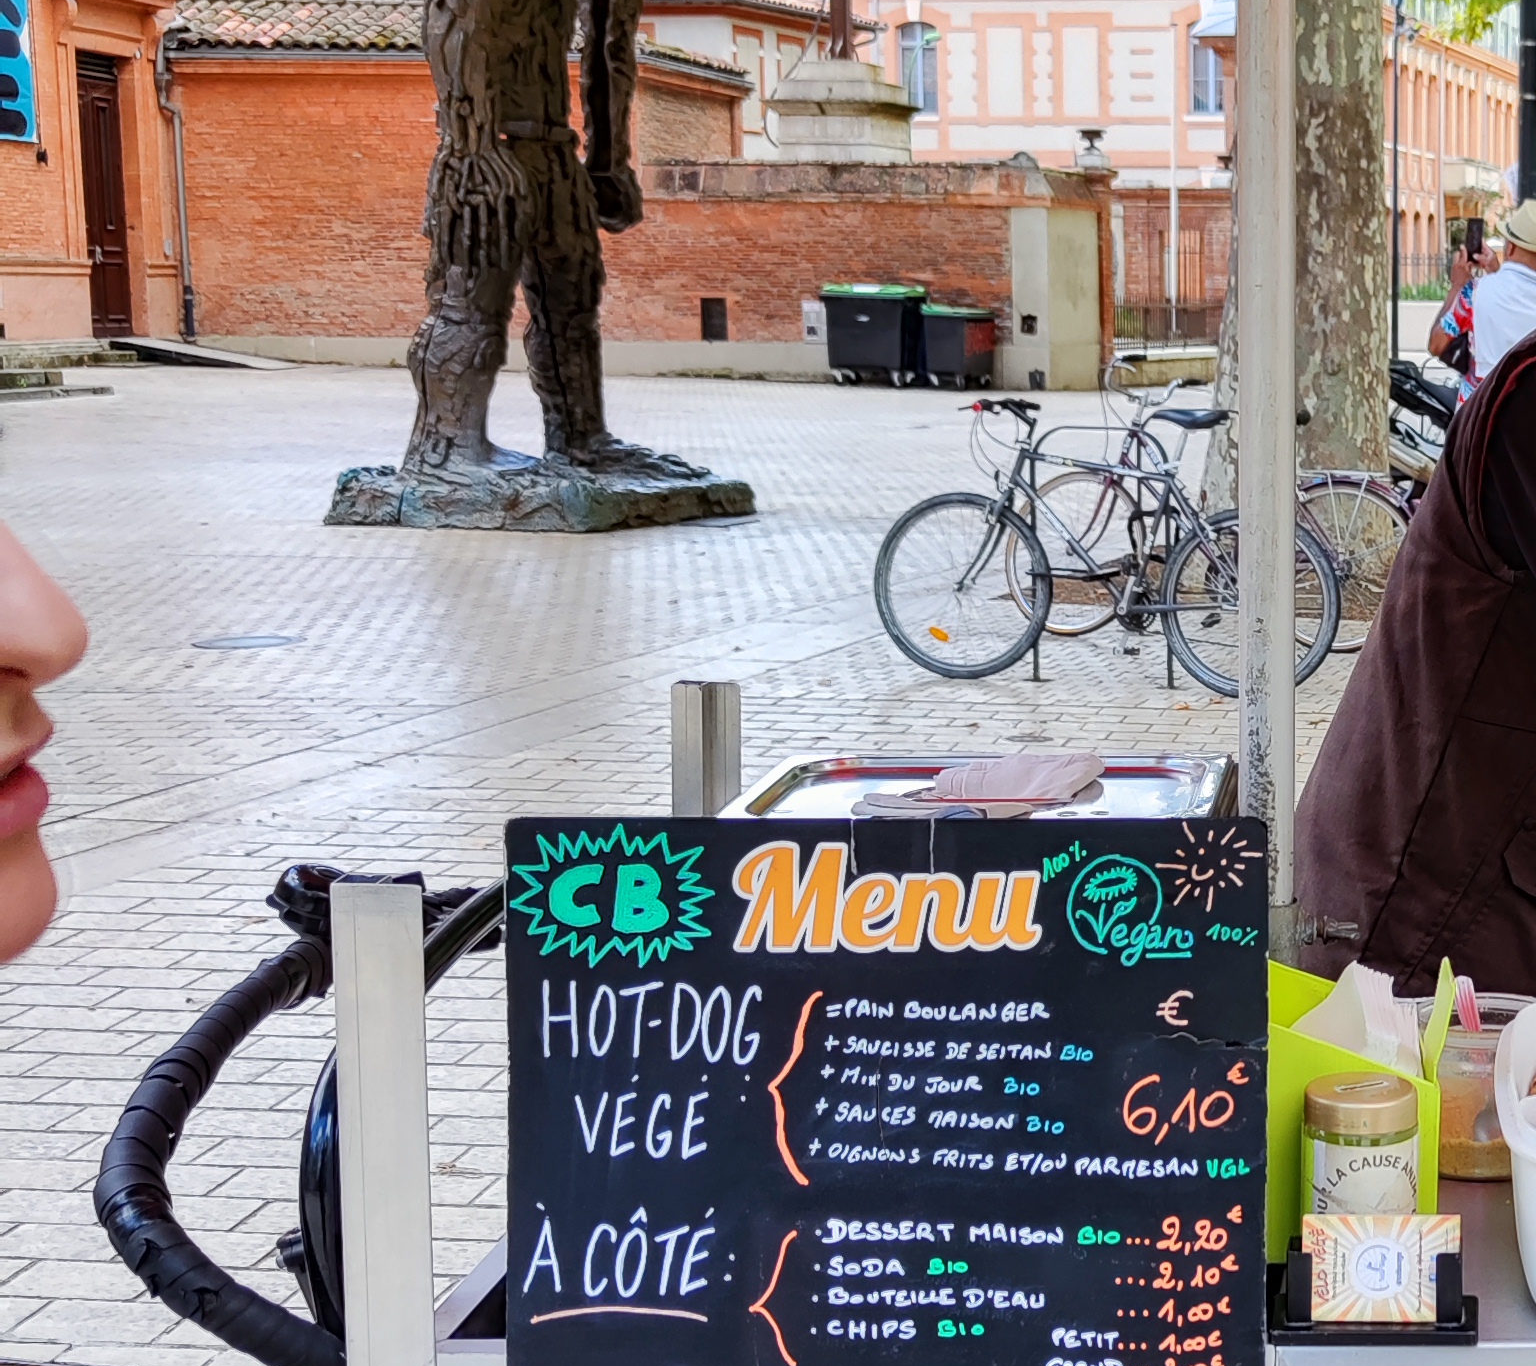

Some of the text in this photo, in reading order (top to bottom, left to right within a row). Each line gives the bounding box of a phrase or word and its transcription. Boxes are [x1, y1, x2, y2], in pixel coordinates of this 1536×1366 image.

[548, 863, 669, 934] CB
[731, 839, 1045, 955] Menu
[1074, 902, 1194, 967] Vegan
[542, 979, 762, 1066] HOT-DOG
[904, 1001, 1050, 1023] BOULANGER
[843, 1036, 936, 1059] SAUCISSE
[945, 1042, 971, 1060] DE
[975, 1042, 1051, 1061] SEITAN
[1060, 1044, 1093, 1062] BIO
[887, 1073, 915, 1094] DU
[924, 1075, 983, 1095] JOUR
[1004, 1077, 1040, 1096] BIO
[834, 1101, 916, 1127] SAUCES
[928, 1110, 1018, 1130] MAISON
[1026, 1116, 1064, 1134] BIO
[827, 1142, 921, 1164] OIGNONS
[933, 1148, 994, 1170] FRITS
[1074, 1156, 1199, 1179] PARMESAN
[1326, 1168, 1347, 1188] LA
[1348, 1155, 1401, 1172] CAUSE
[821, 1217, 954, 1245] DESSERT
[969, 1222, 1064, 1246] MAISON
[1077, 1226, 1120, 1245] BIO
[827, 1253, 905, 1281] SODA
[927, 1258, 968, 1275] BIO
[827, 1285, 956, 1308] BOUTEILLE
[963, 1286, 1045, 1312] D'EAU
[827, 1319, 916, 1340] CHIPS
[938, 1320, 984, 1337] BIO
[1051, 1327, 1122, 1350] PETIT
